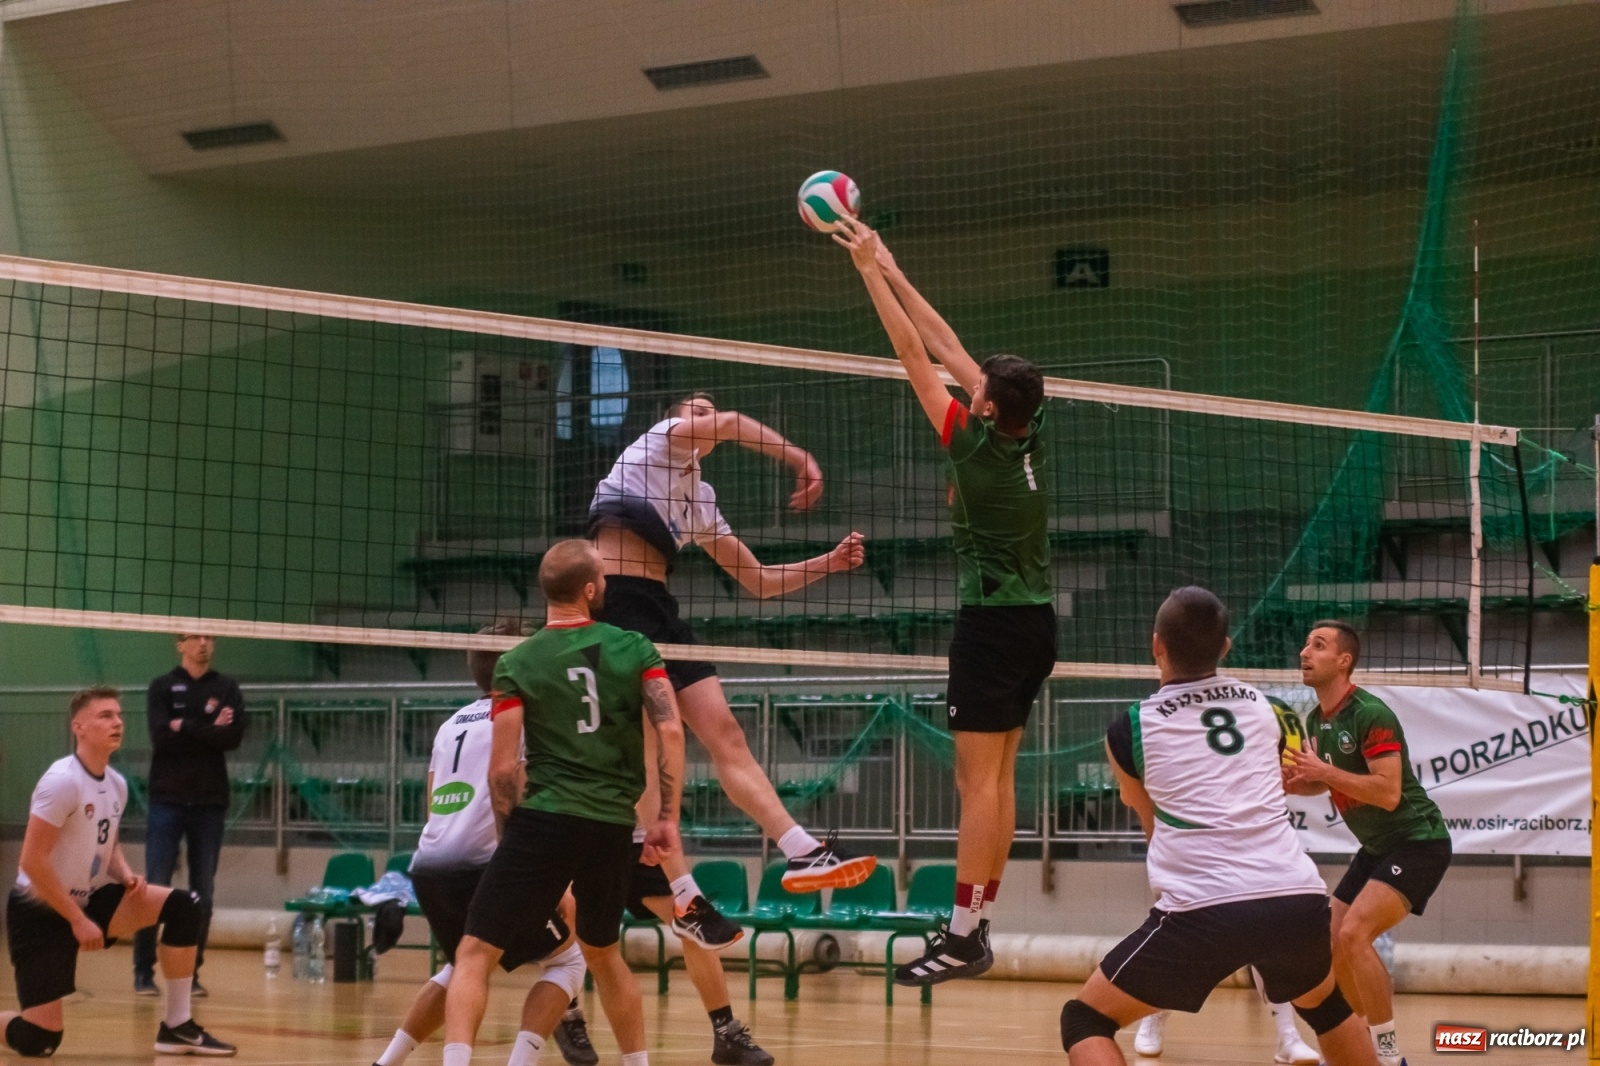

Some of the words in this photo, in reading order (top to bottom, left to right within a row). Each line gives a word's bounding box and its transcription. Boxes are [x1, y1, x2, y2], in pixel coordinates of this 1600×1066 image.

[567, 667, 600, 734] 3
[1156, 700, 1178, 718] KS
[452, 729, 468, 774] 1
[1200, 707, 1245, 756] 8
[1430, 706, 1590, 783] PORZĄDKU
[970, 890, 981, 913] KIPSTA
[546, 919, 562, 940] 1
